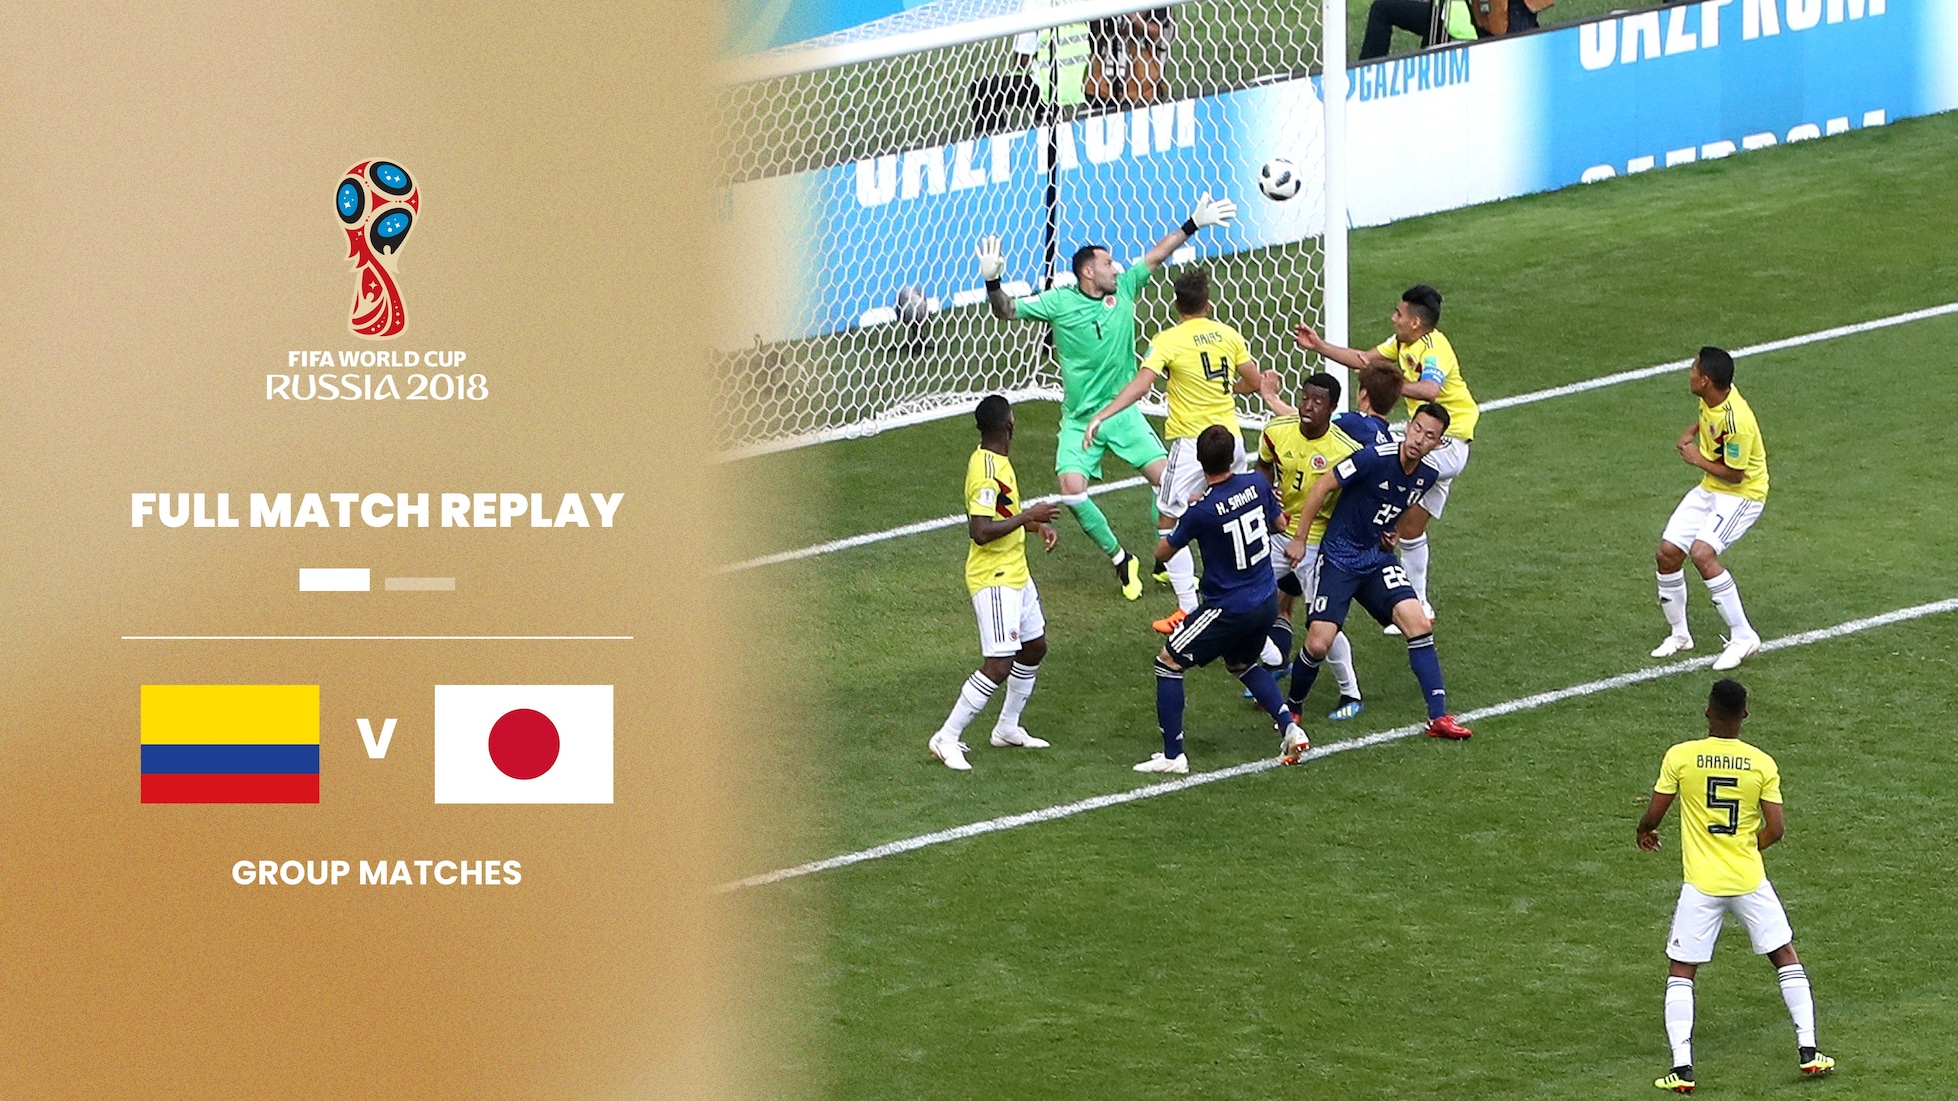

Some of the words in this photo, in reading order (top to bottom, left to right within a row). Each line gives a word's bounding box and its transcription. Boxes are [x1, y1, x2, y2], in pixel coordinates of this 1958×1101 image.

[1359, 47, 1470, 103] GAZPROM
[1200, 350, 1231, 395] 4
[1291, 469, 1304, 491] 3
[1222, 505, 1271, 571] 19
[1713, 514, 1724, 533] 7
[1381, 565, 1411, 590] 22
[1707, 776, 1740, 835] 5
